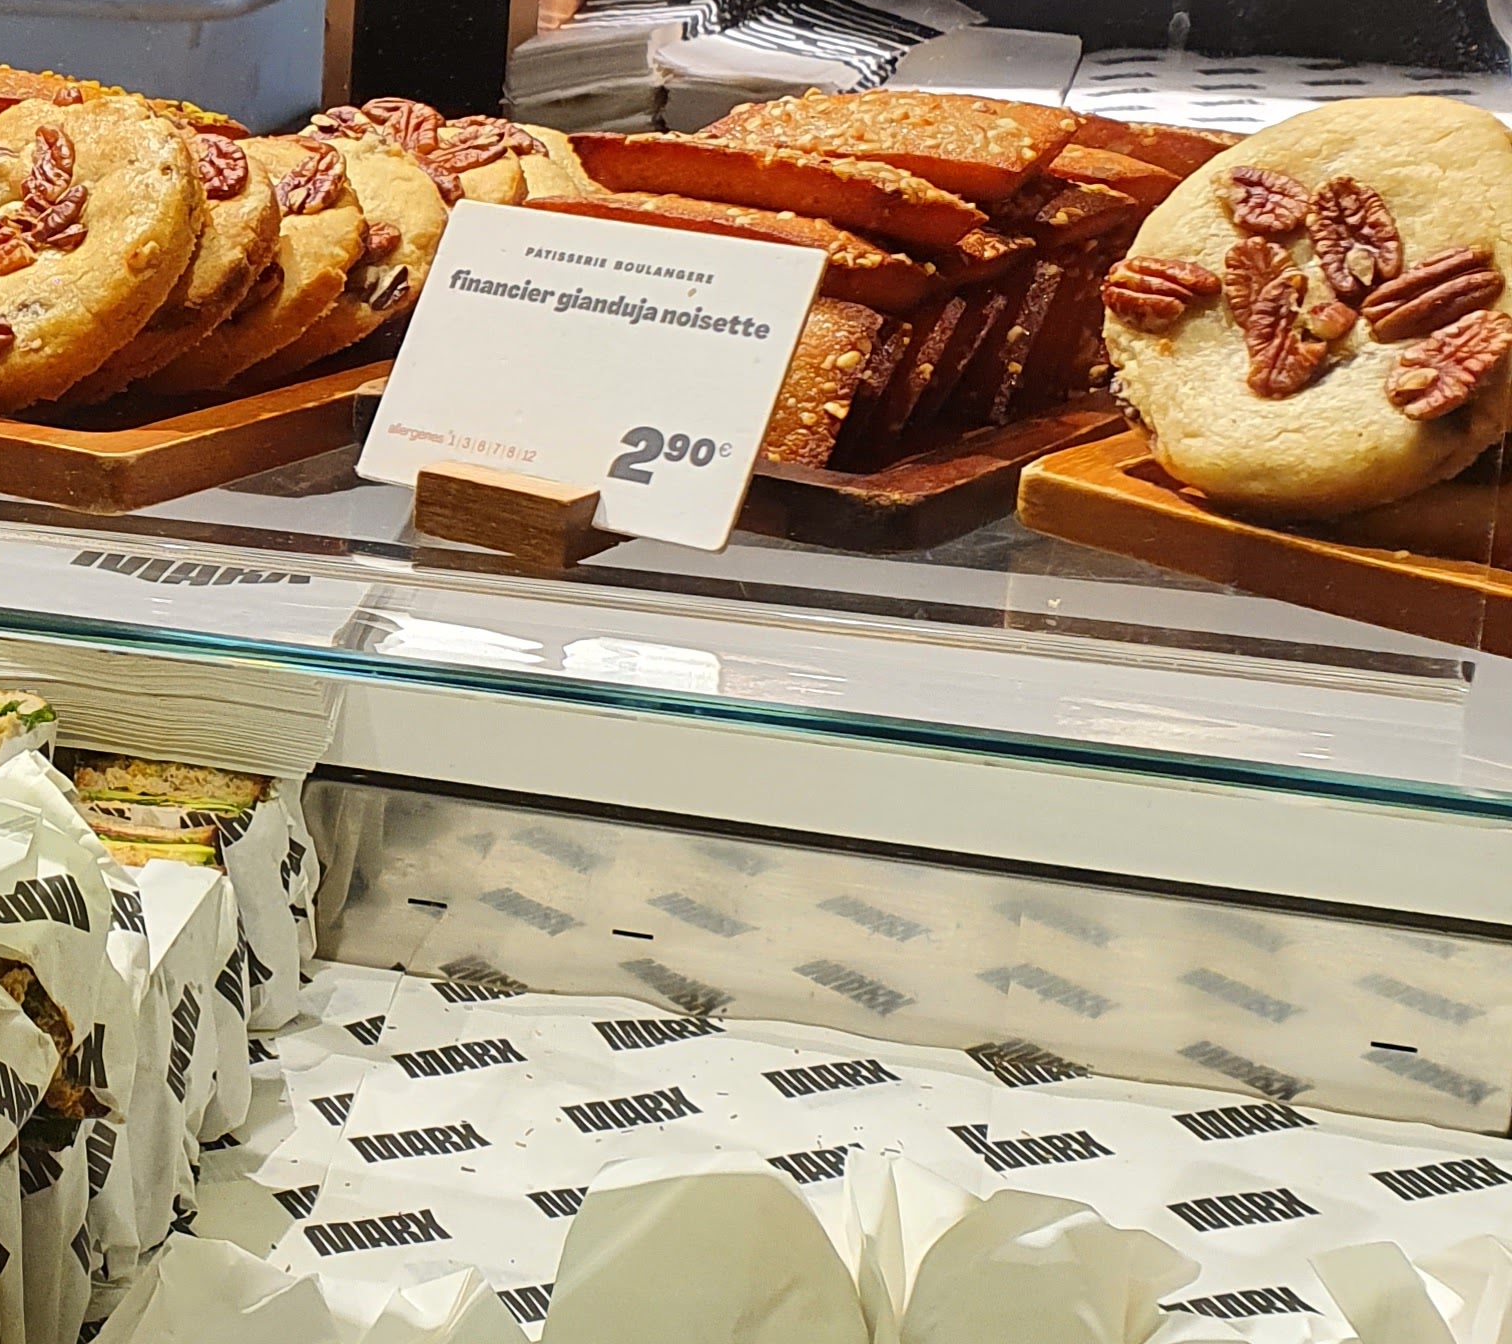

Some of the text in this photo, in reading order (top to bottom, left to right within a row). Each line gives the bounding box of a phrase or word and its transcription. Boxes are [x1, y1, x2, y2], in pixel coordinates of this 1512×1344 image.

[524, 246, 608, 269] PATISSERIE
[448, 268, 771, 340] financier gianduja noisette
[391, 1038, 529, 1078] MARX
[760, 1058, 902, 1098] MARX
[561, 1086, 704, 1134] MARX
[1172, 1102, 1319, 1141] MARX
[347, 1122, 493, 1164] MARX
[1166, 1187, 1322, 1232] MARX
[303, 1208, 454, 1257] MARX
